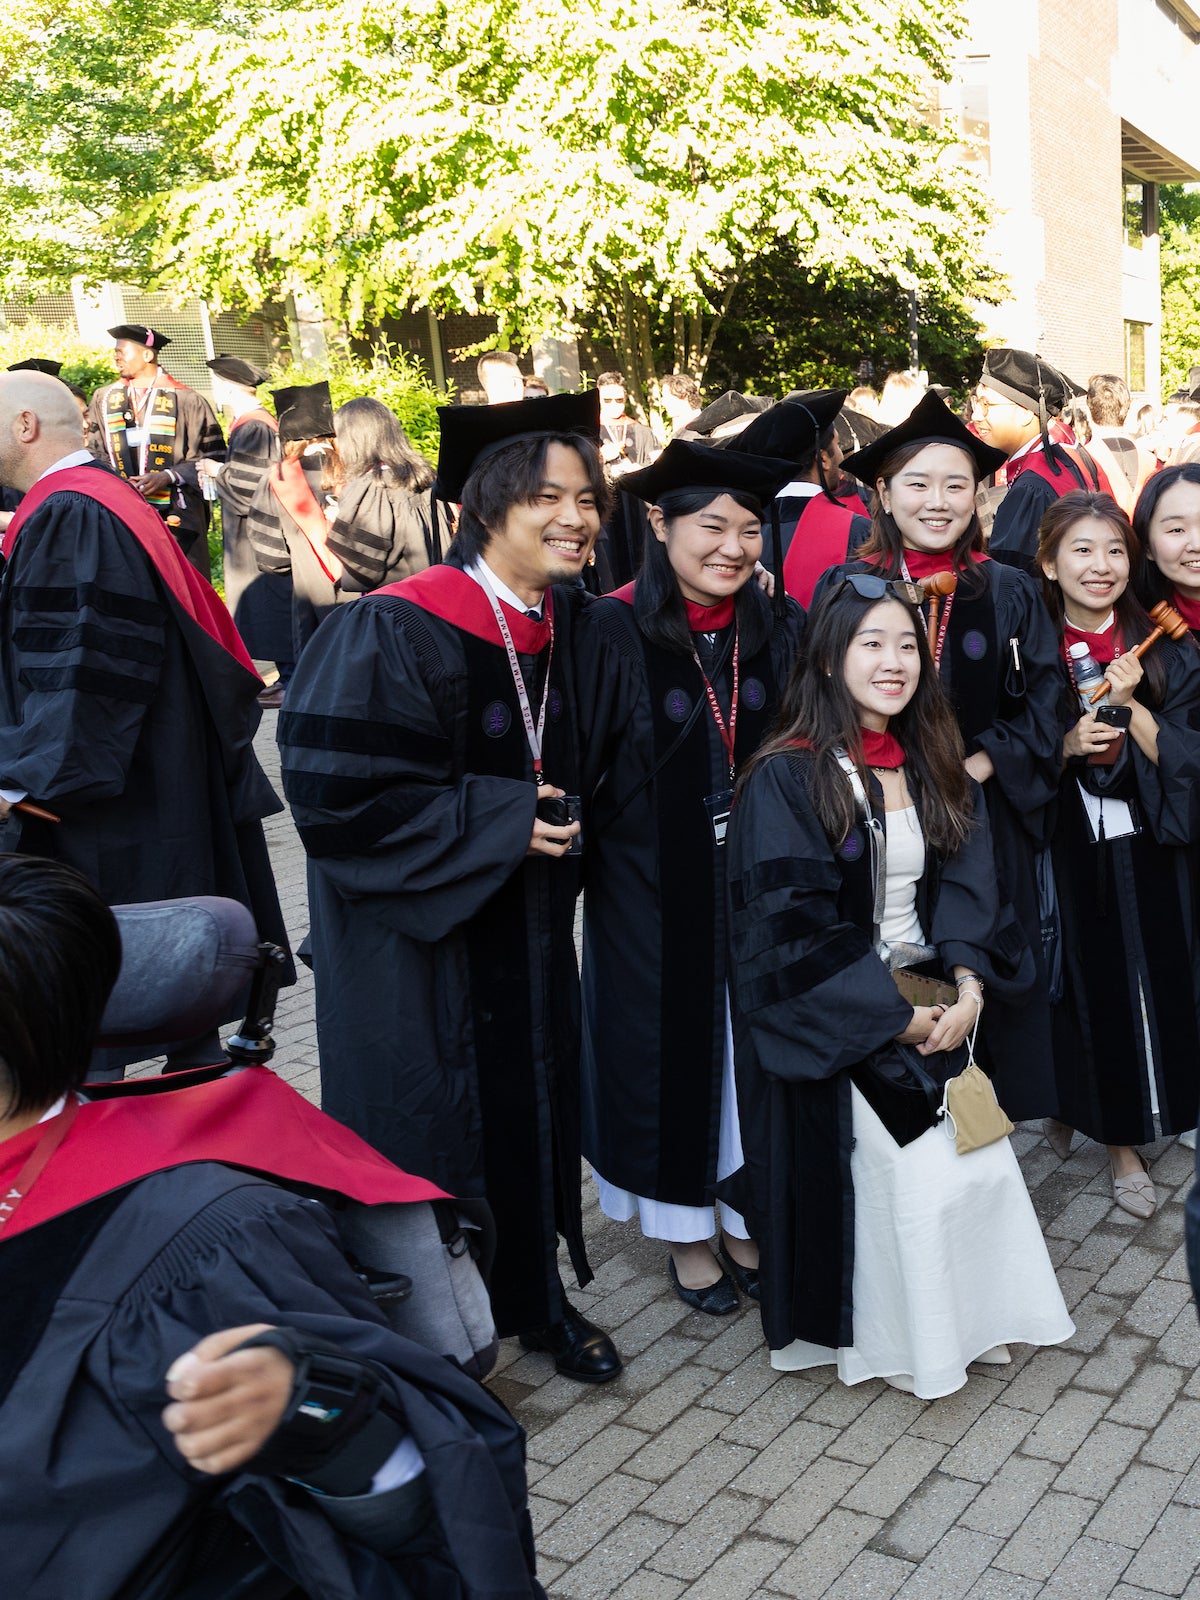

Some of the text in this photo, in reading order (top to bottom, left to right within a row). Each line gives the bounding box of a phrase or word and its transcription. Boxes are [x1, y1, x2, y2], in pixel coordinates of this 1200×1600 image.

[150, 443, 172, 454] CLASS
[155, 457, 165, 465] OF
[934, 624, 945, 661] ARVARD
[706, 686, 725, 730] HARVARD
